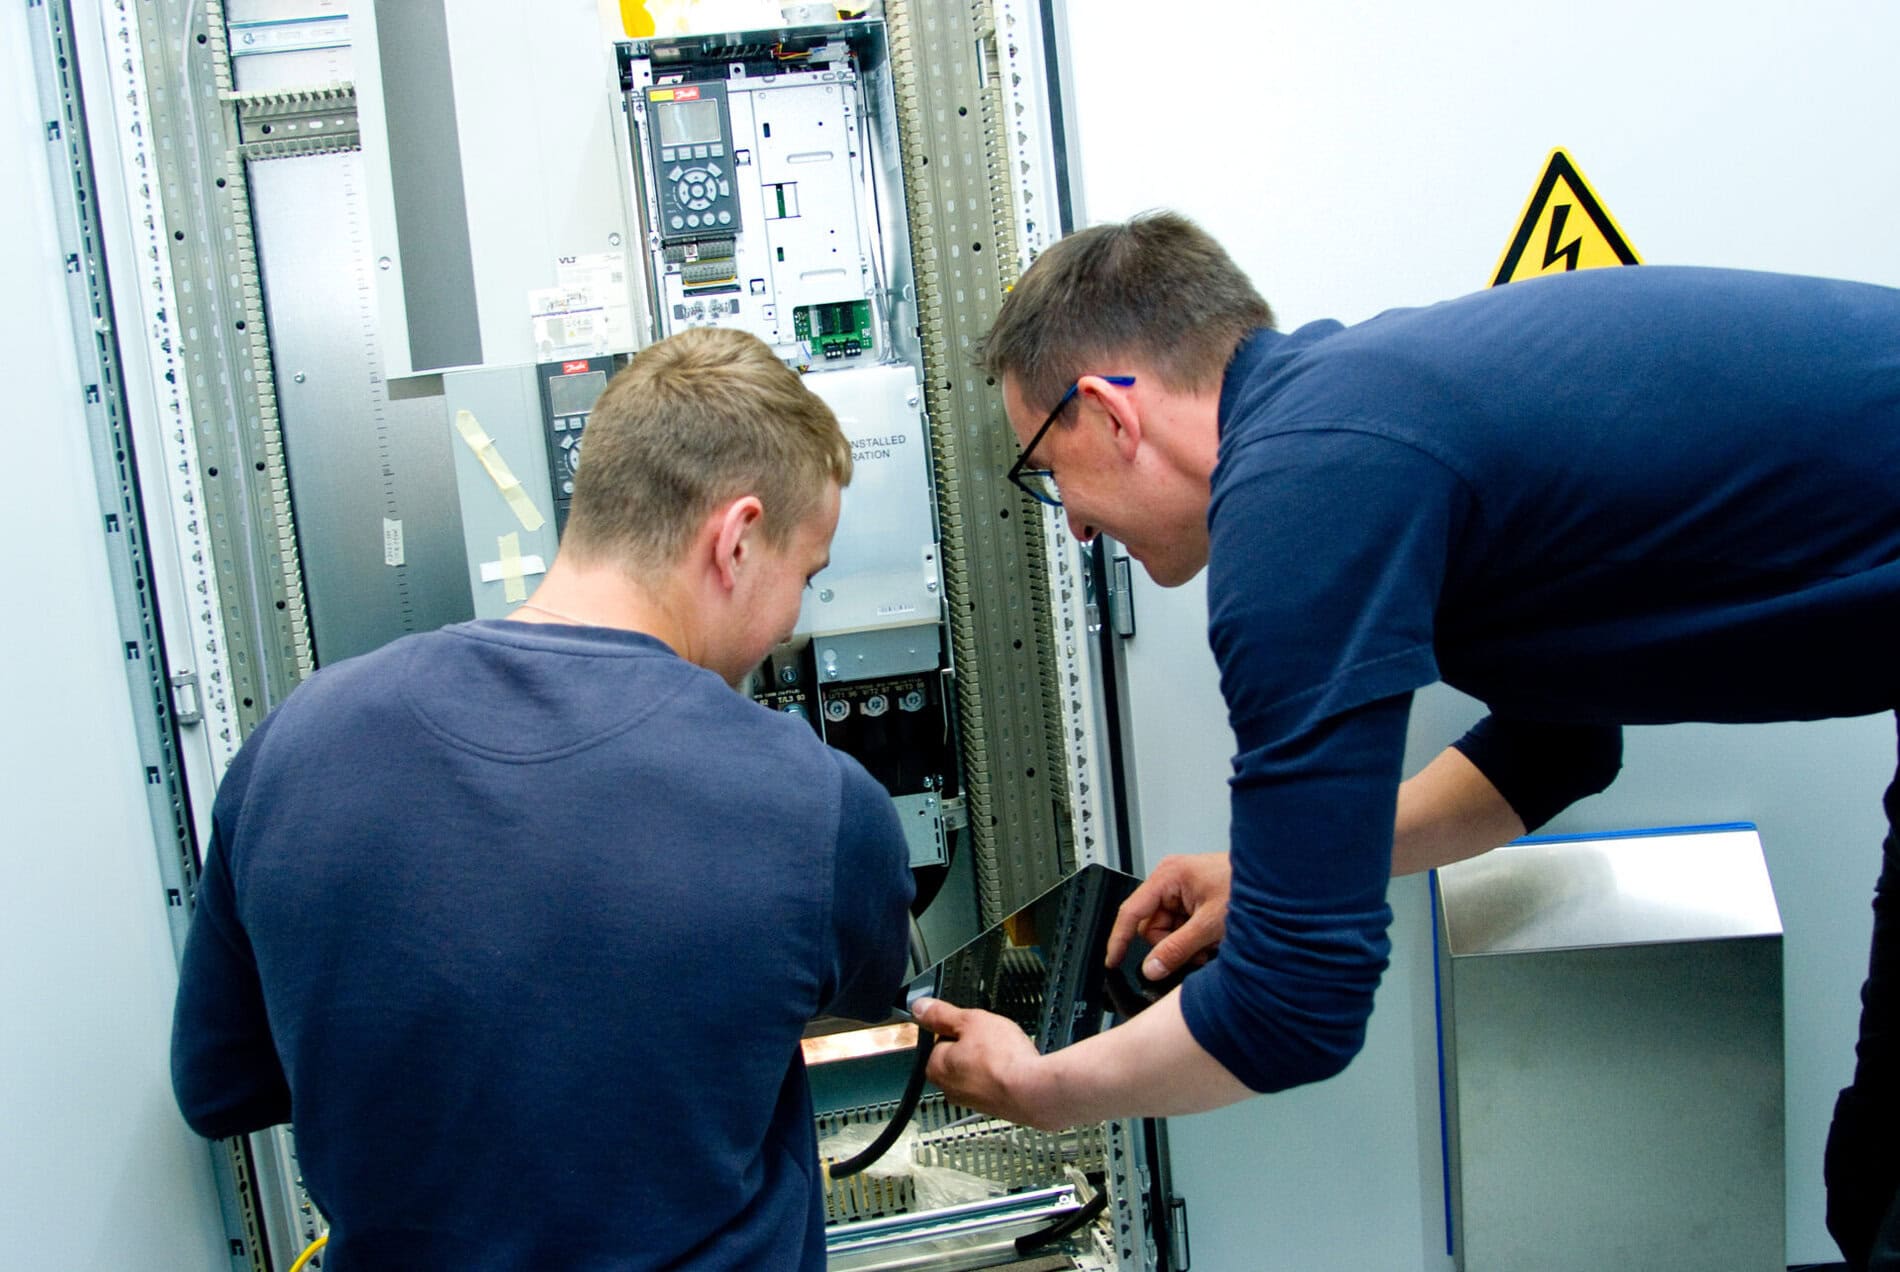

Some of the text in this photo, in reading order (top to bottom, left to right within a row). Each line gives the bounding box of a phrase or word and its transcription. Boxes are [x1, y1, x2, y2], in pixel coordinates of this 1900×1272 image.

[558, 256, 577, 264] VLT
[850, 434, 906, 449] NSTALLED
[852, 449, 890, 461] RATION
